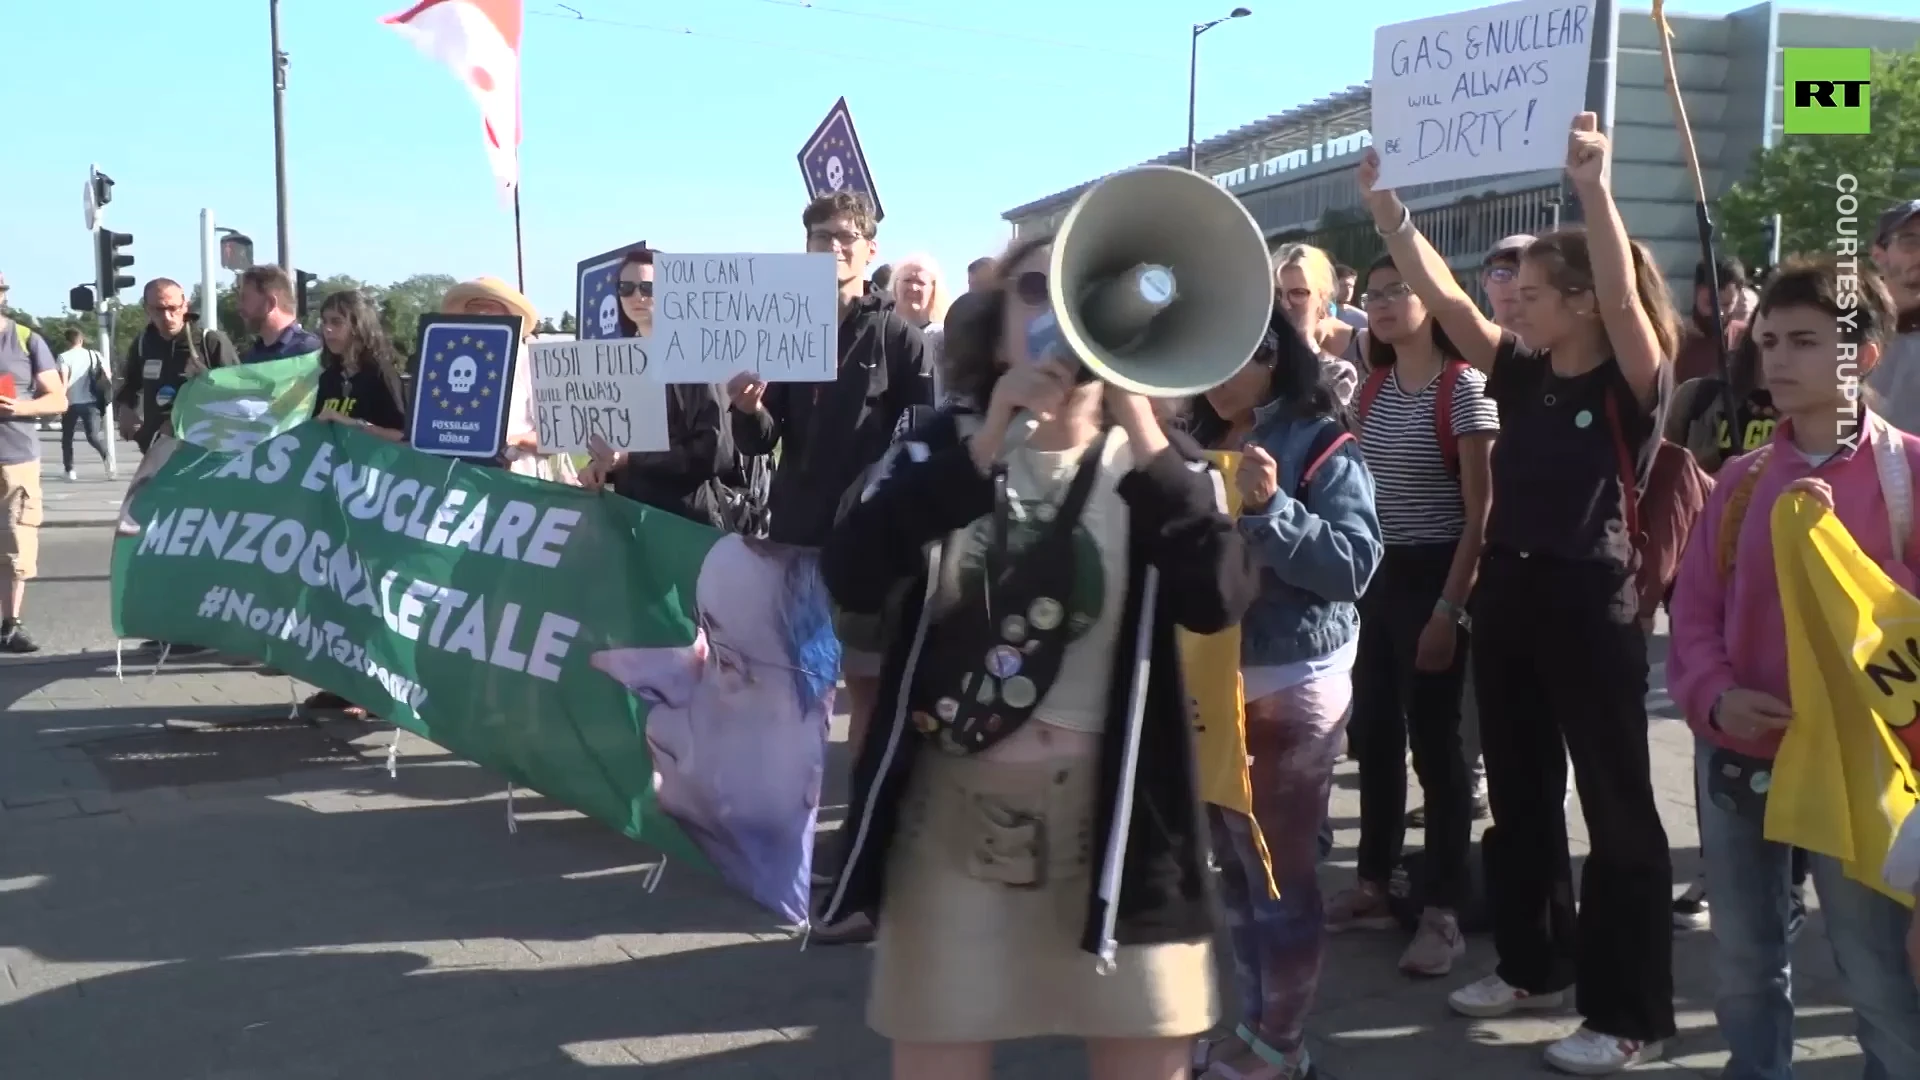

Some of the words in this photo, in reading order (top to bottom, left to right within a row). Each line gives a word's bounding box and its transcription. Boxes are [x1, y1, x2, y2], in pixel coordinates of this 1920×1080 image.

[1391, 31, 1453, 77] GAS
[1466, 25, 1483, 60] &
[1486, 5, 1588, 58] NUCLEAR
[1408, 94, 1442, 108] WILL
[1451, 59, 1549, 103] ALWAYS
[1385, 137, 1402, 155] BE
[661, 259, 696, 284] YOU
[704, 257, 756, 286] CAN'T
[663, 290, 812, 329] GREENWASH
[665, 330, 685, 361] A
[700, 327, 747, 363] DEAD
[756, 323, 831, 373] PLANET
[565, 380, 622, 403] ALWAYS
[431, 419, 481, 432] FOSSILGAS
[537, 404, 565, 448] BE
[570, 403, 632, 448] DIRTY
[214, 433, 300, 484] AS
[301, 441, 334, 492] E
[333, 458, 582, 569] NUCLEARE
[136, 507, 382, 618] MENZOGNA
[379, 568, 581, 683] LETALE
[197, 584, 428, 720] #NotMyTaxoomy
